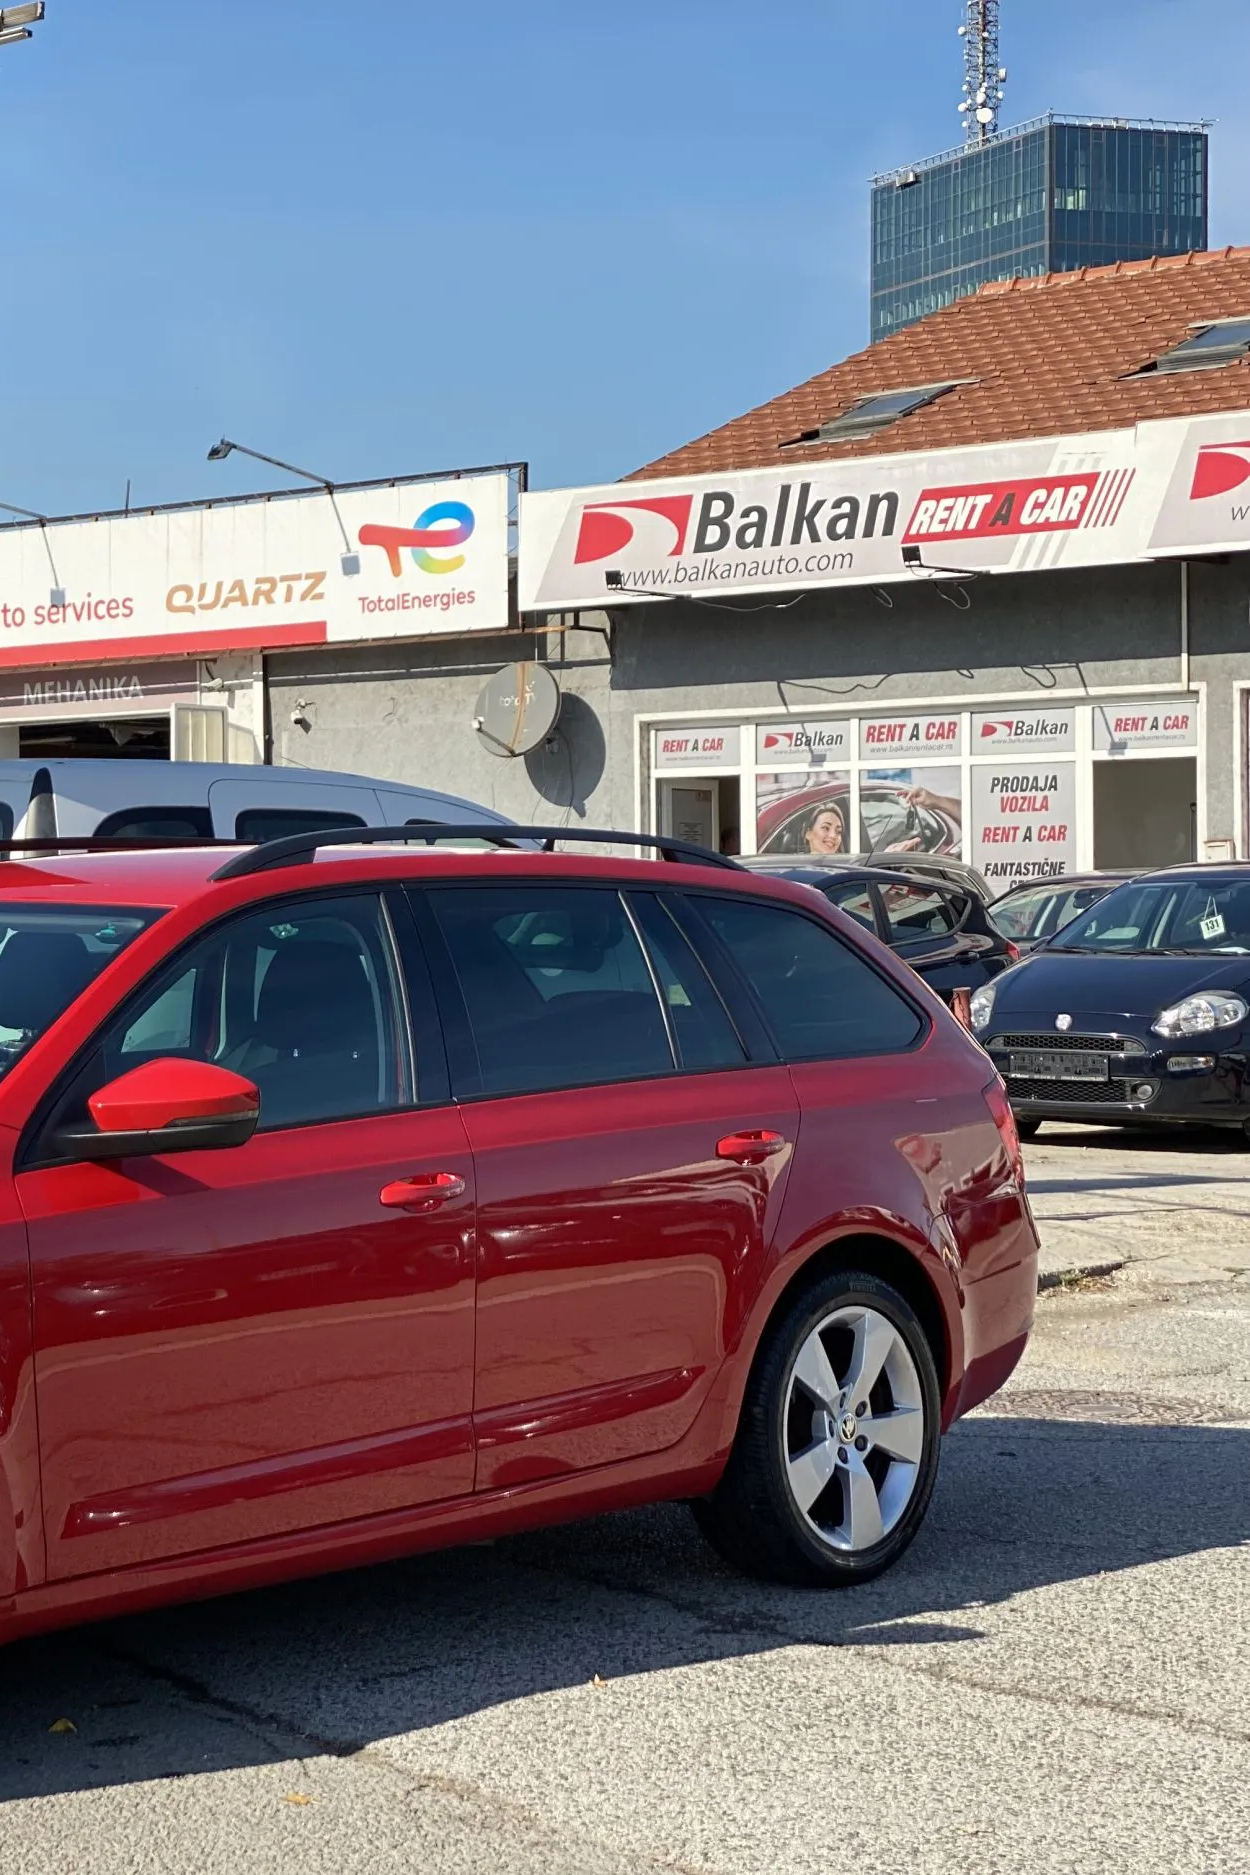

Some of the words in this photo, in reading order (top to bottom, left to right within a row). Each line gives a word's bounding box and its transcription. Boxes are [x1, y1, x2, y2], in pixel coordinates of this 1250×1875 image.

[692, 482, 900, 555] Balkan
[910, 492, 991, 536] RENT
[988, 492, 1017, 527] A
[1020, 485, 1088, 525] CAR
[165, 570, 327, 615] QUARTZ
[358, 588, 476, 614] TotalEnergies
[34, 592, 134, 626] services
[23, 675, 144, 705] MEHANIKA
[866, 723, 906, 744] RENT
[909, 722, 920, 741] A
[925, 721, 958, 741] CAR
[1014, 719, 1069, 737] Balkan
[1114, 716, 1148, 733] RENT
[1150, 716, 1159, 731] A
[1163, 715, 1189, 731] CAR
[662, 739, 691, 753] RENT
[692, 738, 699, 752] A
[702, 737, 724, 752] CAR
[794, 730, 844, 748] Balkan
[990, 774, 1058, 793] PRODAJA
[1000, 795, 1049, 813] VOZILA
[981, 826, 1020, 843] RENT
[1022, 826, 1033, 842] A
[1037, 824, 1067, 842] CAR
[984, 857, 1066, 877] FANTASTIČNE
[1205, 918, 1219, 931] 131
